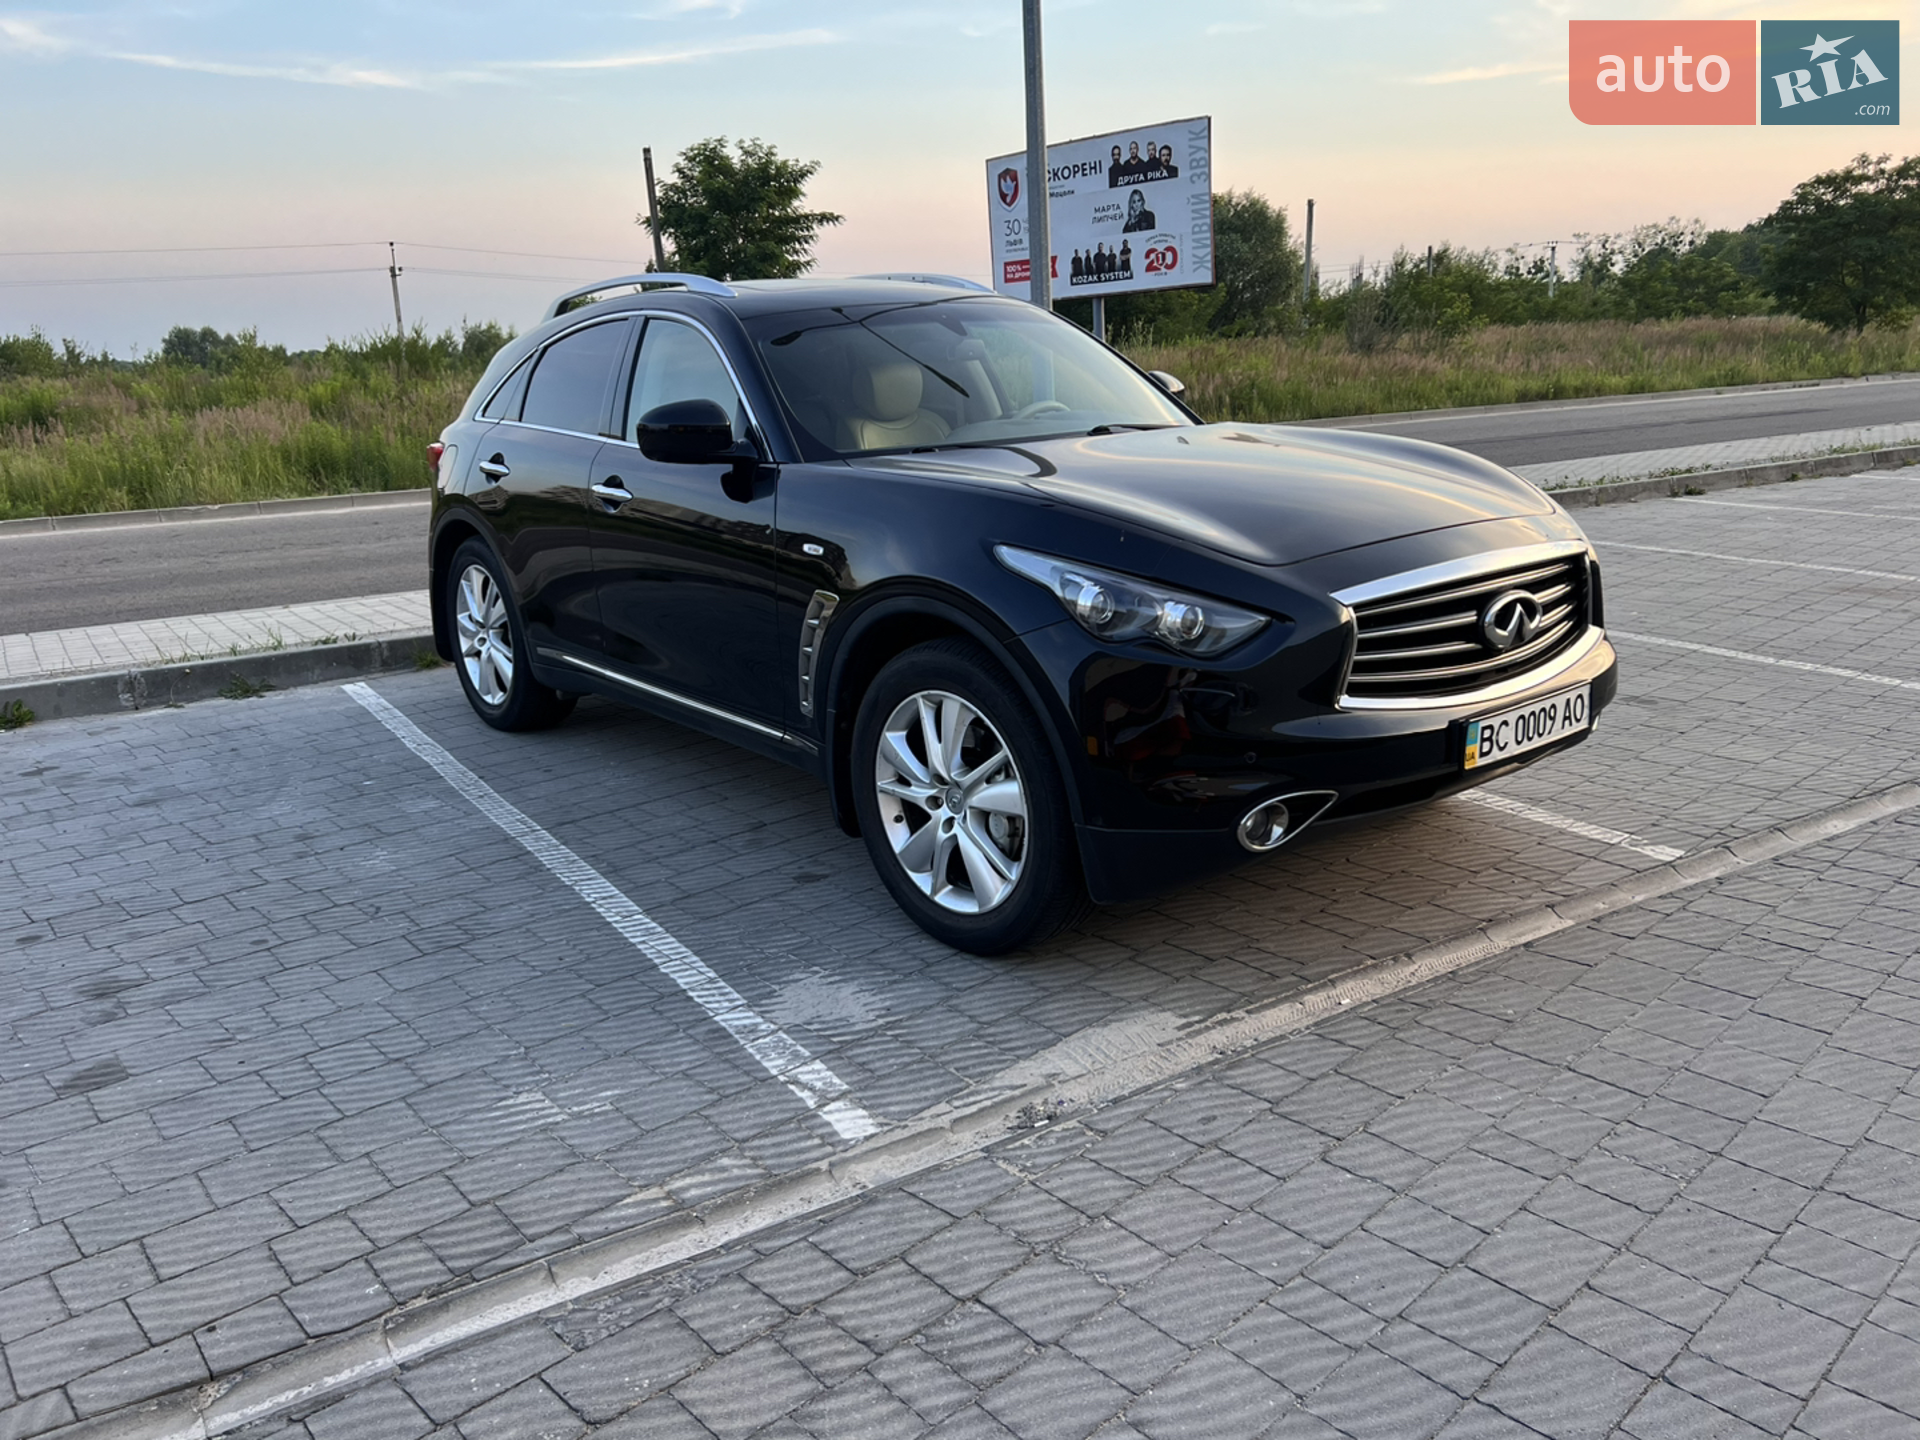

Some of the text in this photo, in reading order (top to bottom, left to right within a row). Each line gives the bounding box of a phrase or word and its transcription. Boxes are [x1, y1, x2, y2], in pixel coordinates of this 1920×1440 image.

[1117, 169, 1168, 186] ДРУГА РІКА
[1094, 203, 1121, 214] МАРТА
[1187, 126, 1211, 274] ЖИВИЙ ЗВУК
[1091, 211, 1124, 224] ЛИПЧЕЙ
[1003, 218, 1021, 237] 30
[1071, 270, 1131, 284] KOZAK SYSTEM
[1478, 693, 1585, 758] BC 0009 AO
